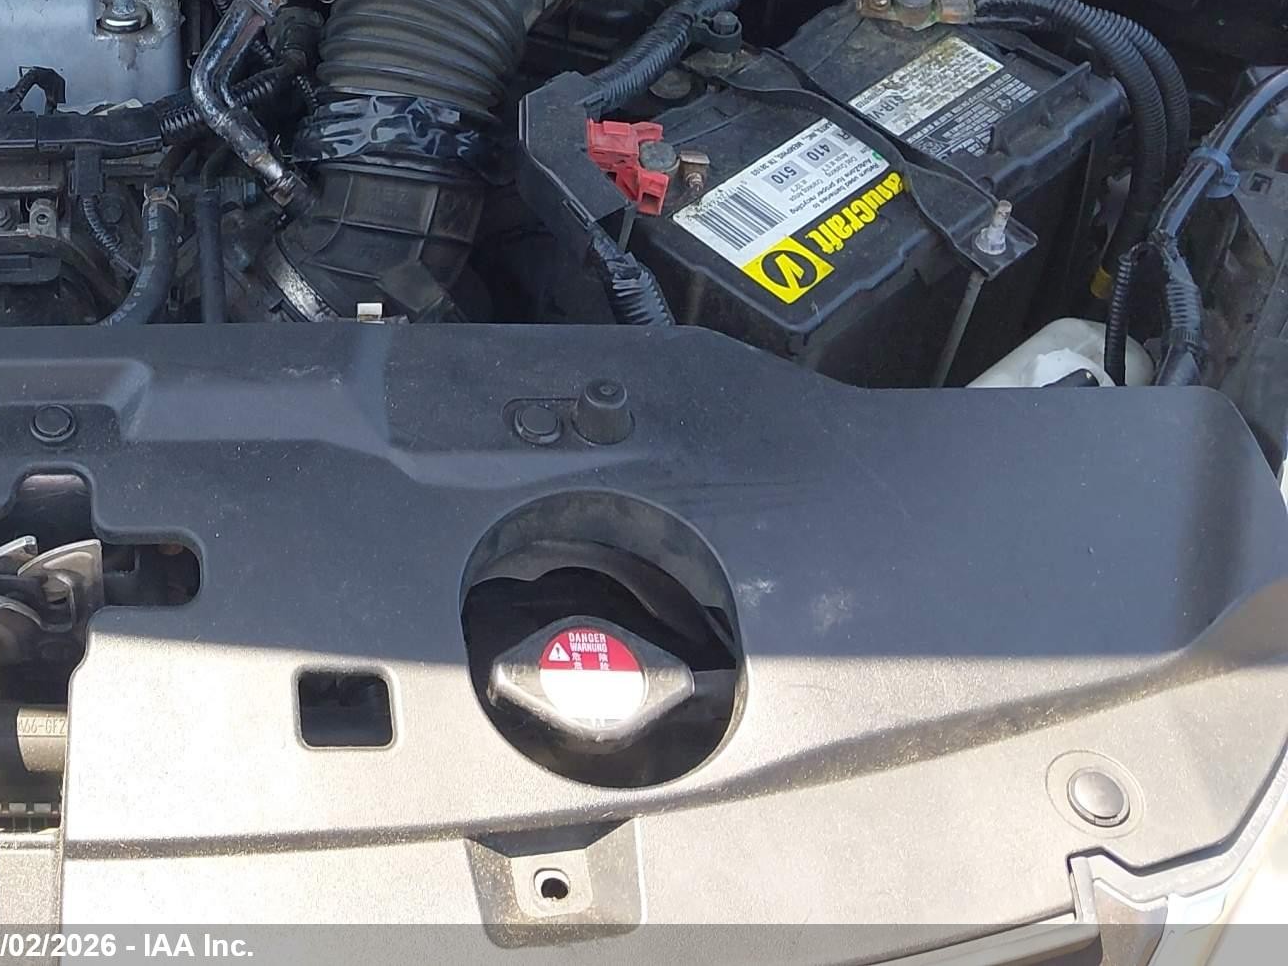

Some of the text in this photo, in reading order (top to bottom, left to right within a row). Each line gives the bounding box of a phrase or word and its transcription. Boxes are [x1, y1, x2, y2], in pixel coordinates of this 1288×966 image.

[805, 143, 832, 161] 410
[769, 165, 797, 184] 510
[568, 632, 606, 642] DANGER
